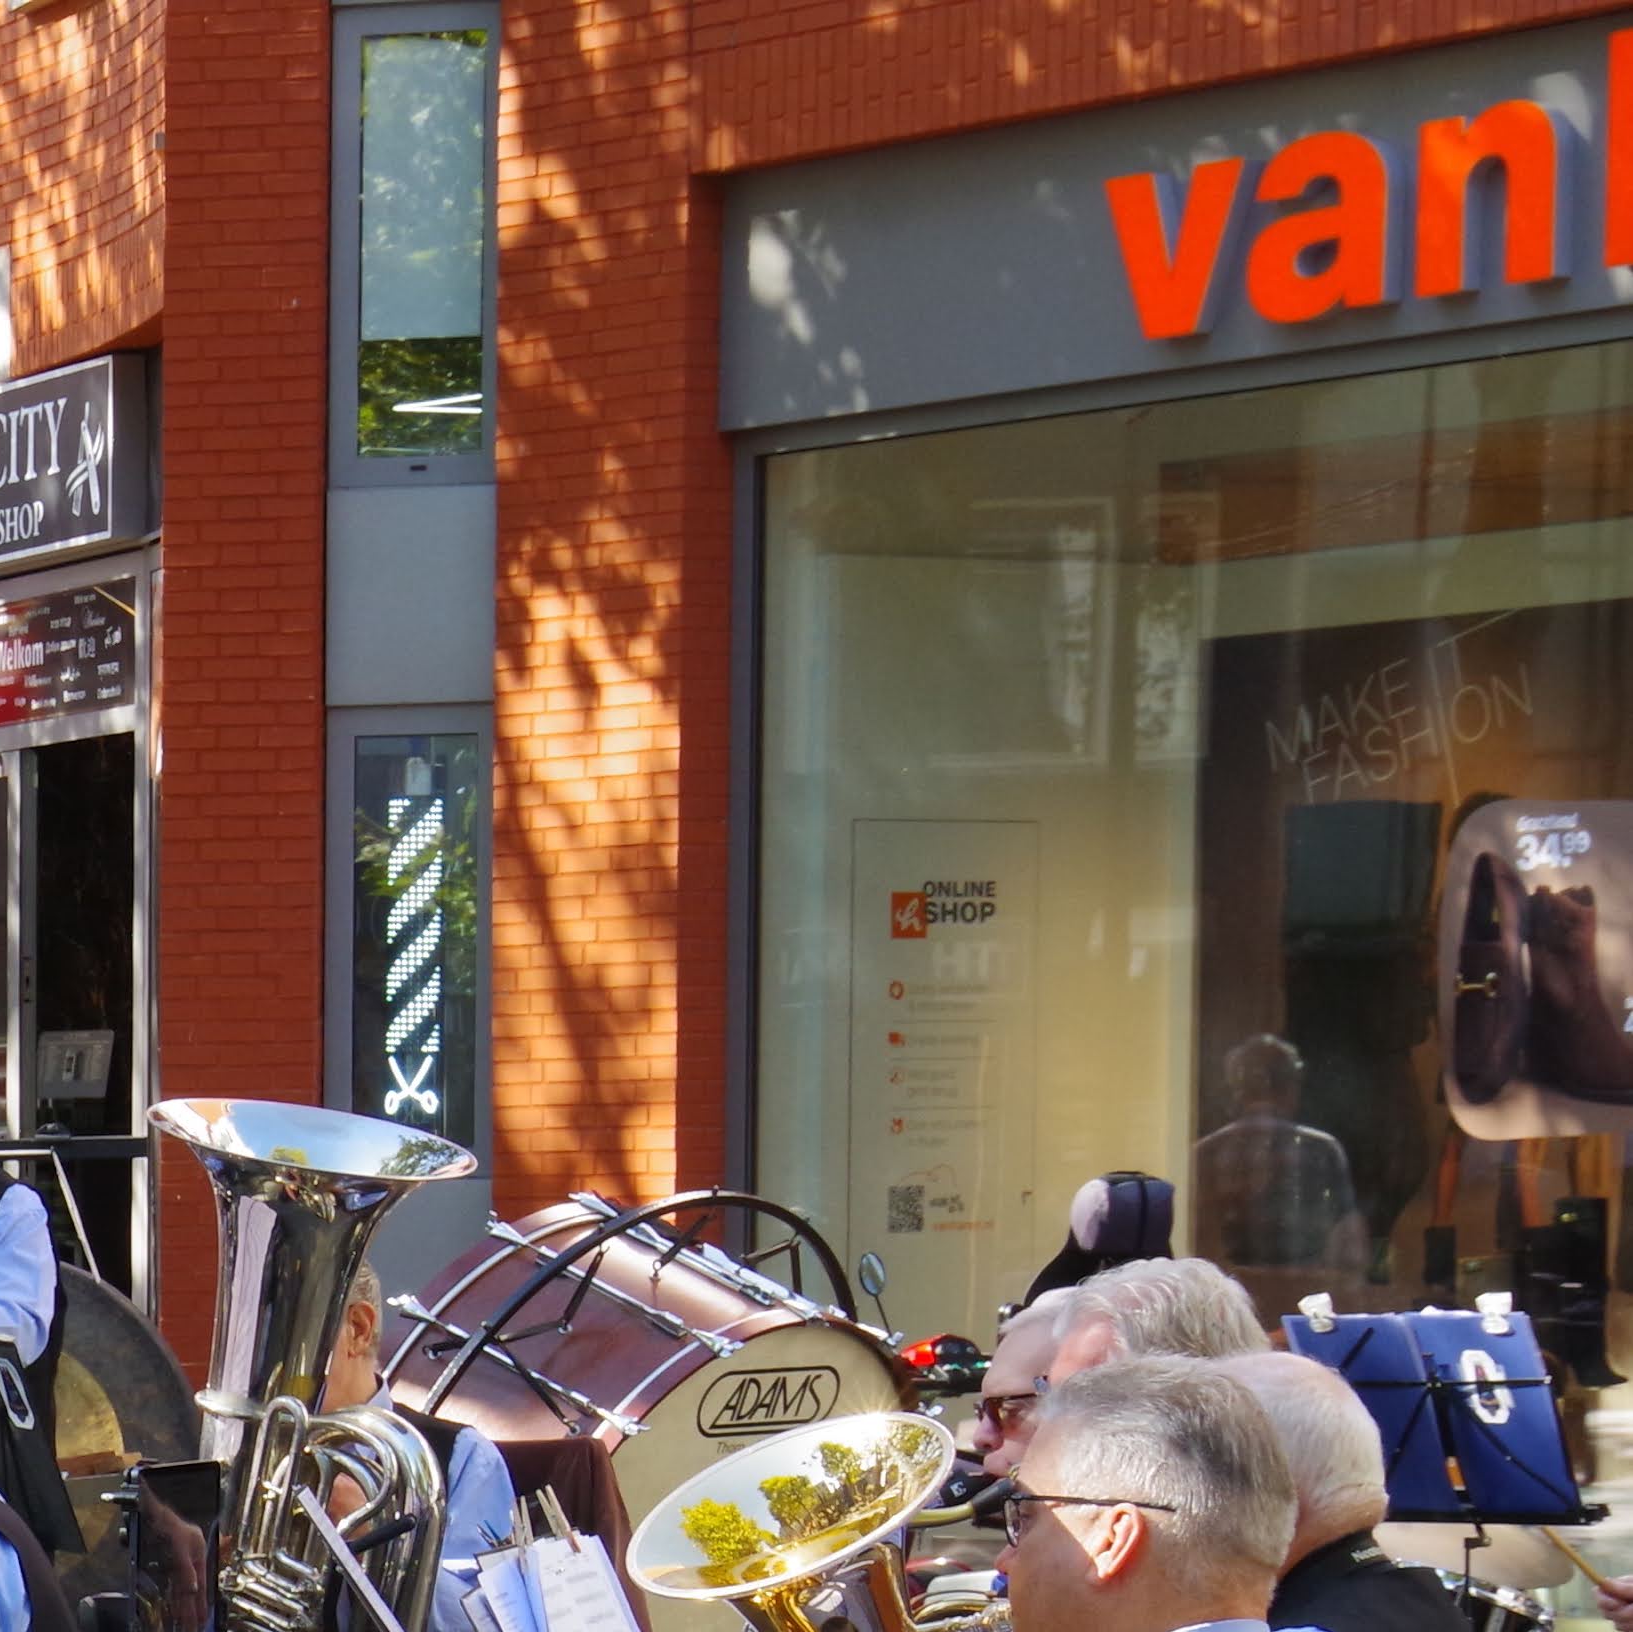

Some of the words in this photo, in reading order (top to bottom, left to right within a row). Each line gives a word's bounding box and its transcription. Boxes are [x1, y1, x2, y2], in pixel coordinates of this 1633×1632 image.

[1104, 28, 1633, 340] van
[1265, 657, 1418, 774] MAKE
[923, 880, 997, 898] ONLINE
[923, 901, 997, 924] SHOP
[711, 1372, 823, 1426] ADAMS
